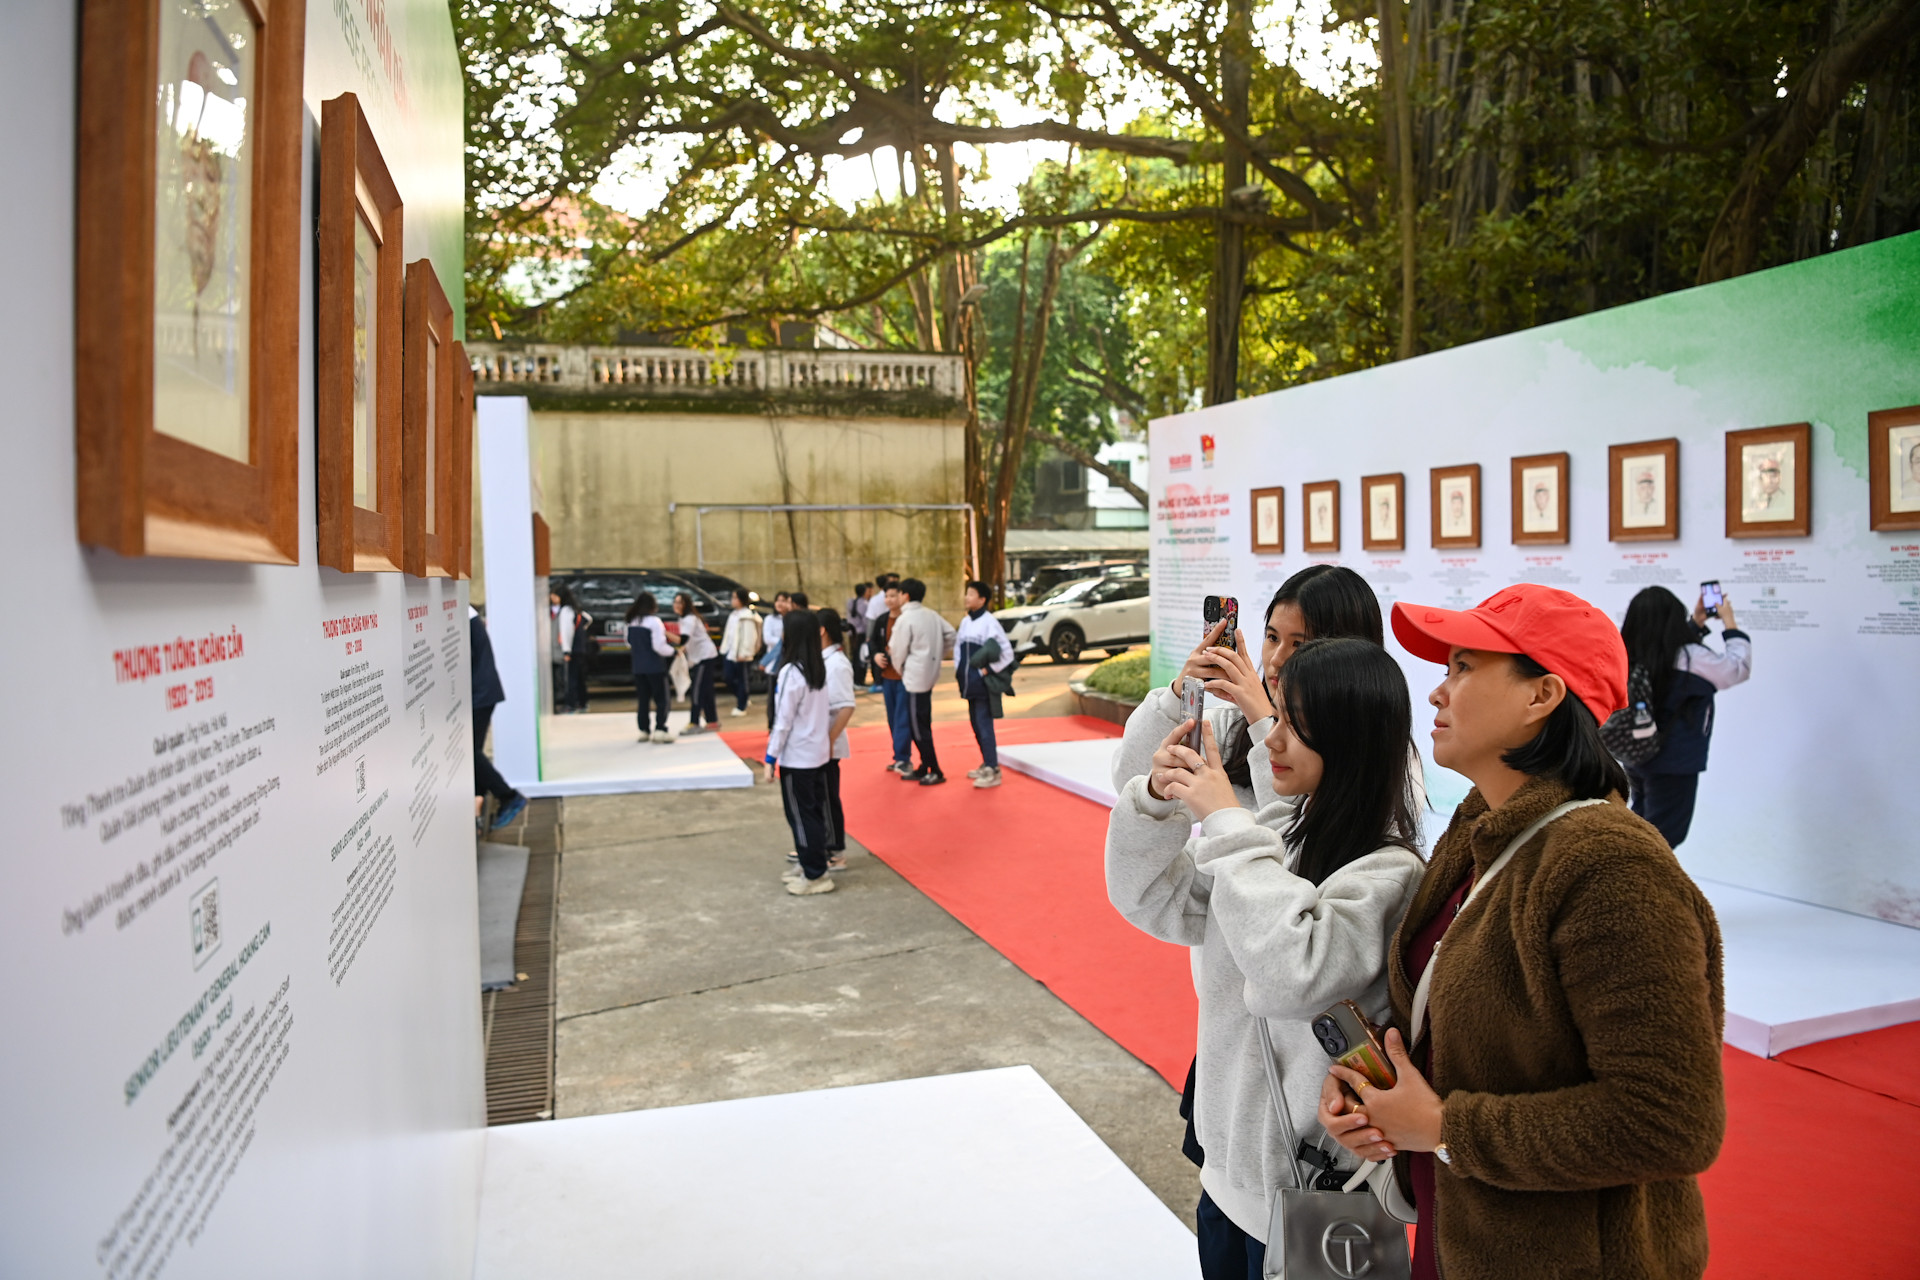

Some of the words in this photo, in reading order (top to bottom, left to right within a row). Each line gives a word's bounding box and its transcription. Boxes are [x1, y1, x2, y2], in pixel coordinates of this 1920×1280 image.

[351, 613, 362, 633] HOÀNG
[113, 645, 161, 684] THƯỢNG
[162, 636, 196, 672] TƯỚNG
[198, 632, 226, 666] HOÀNG
[209, 964, 238, 1003] GENERAL
[239, 936, 259, 965] HOANG
[259, 922, 271, 945] CAM
